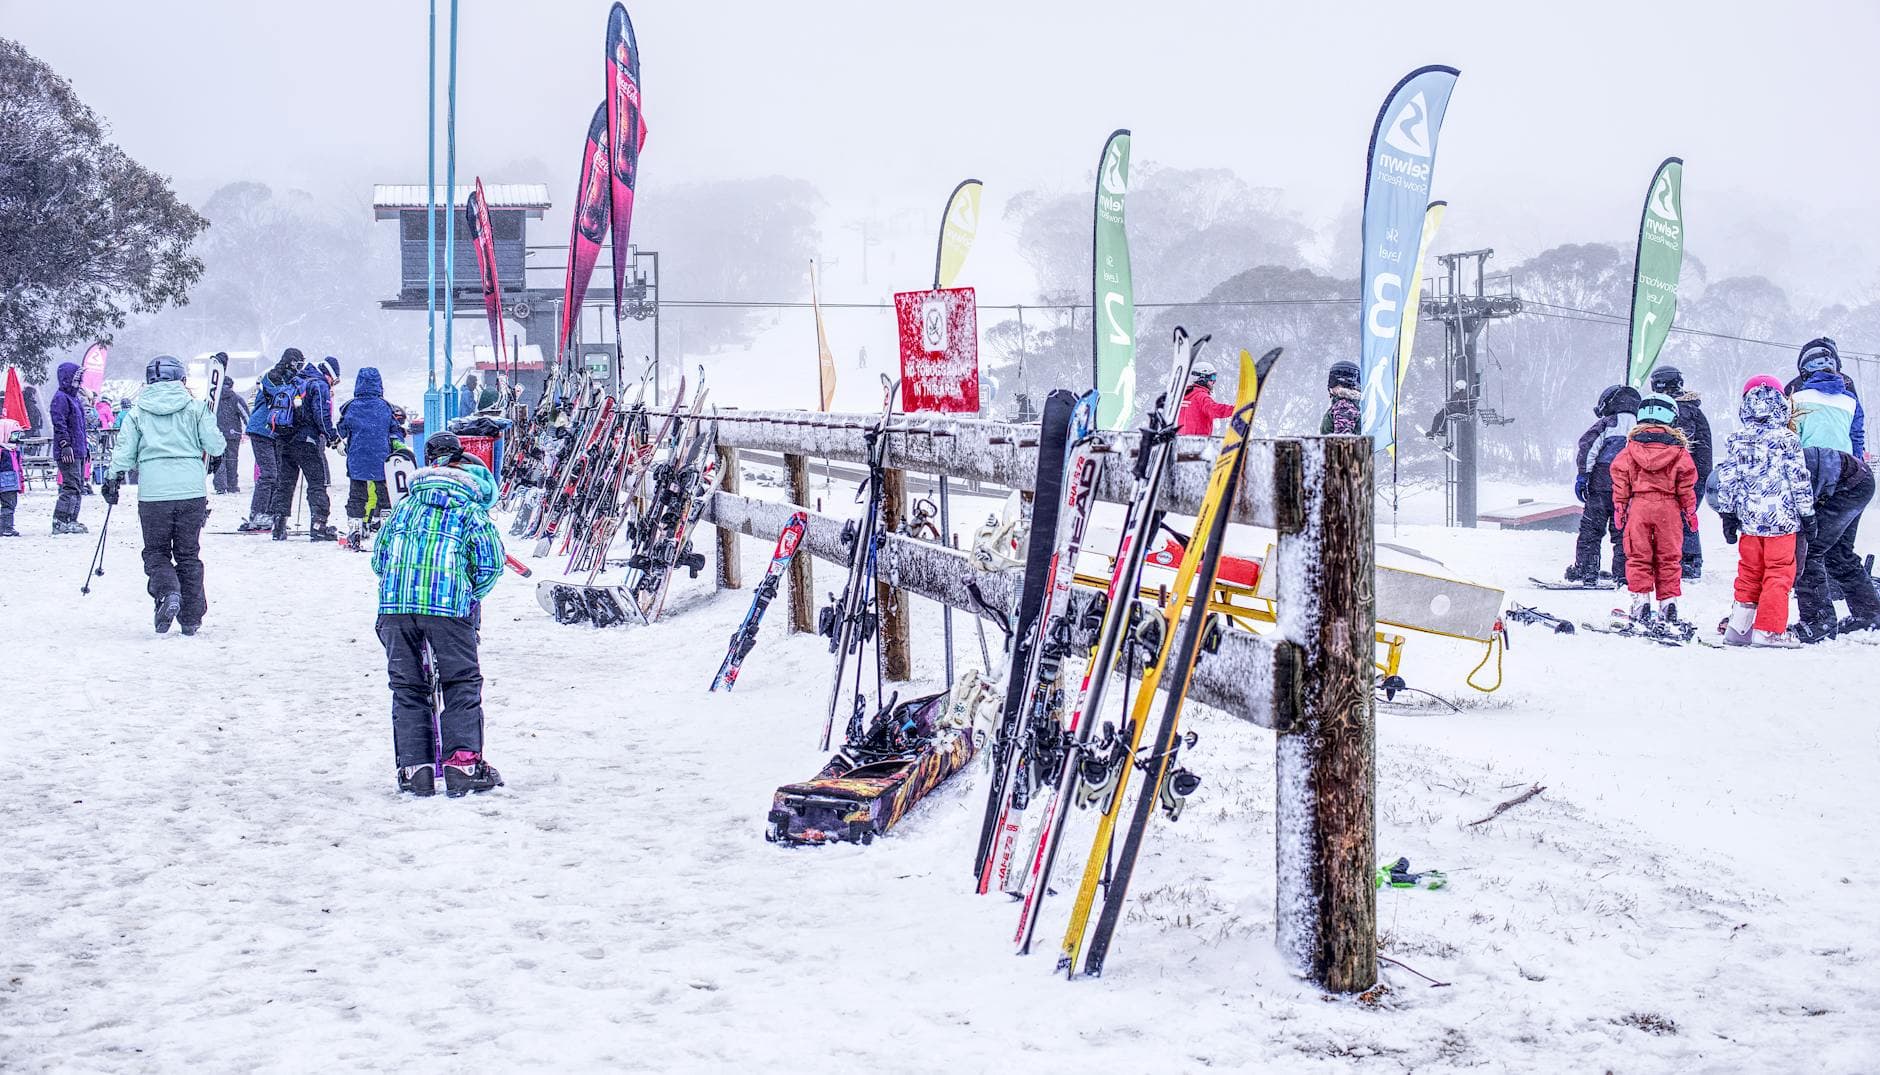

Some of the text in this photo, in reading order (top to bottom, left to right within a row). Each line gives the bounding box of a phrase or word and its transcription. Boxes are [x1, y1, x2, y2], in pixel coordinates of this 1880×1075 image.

[904, 364, 914, 378] NO
[208, 369, 219, 413] EAD
[1077, 456, 1086, 471] 72
[1068, 459, 1096, 567] HEAD
